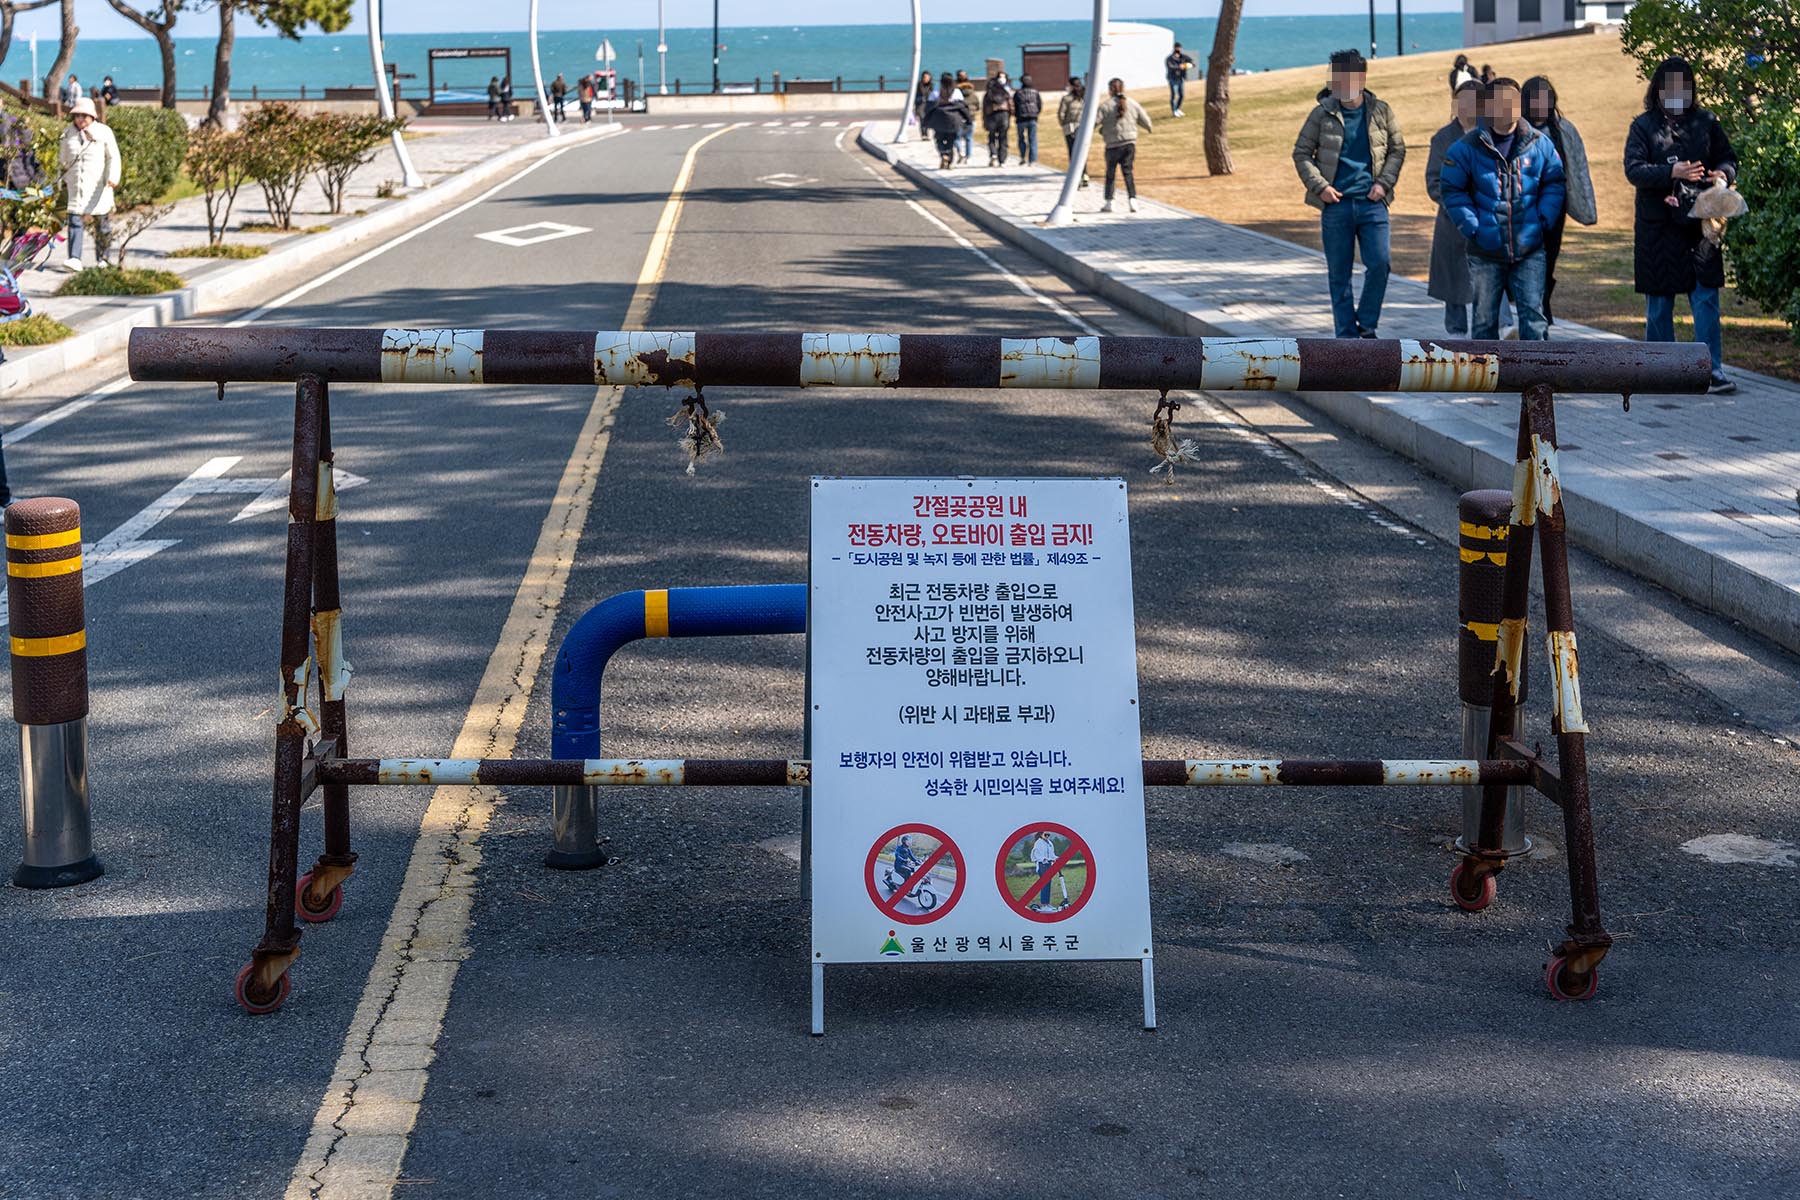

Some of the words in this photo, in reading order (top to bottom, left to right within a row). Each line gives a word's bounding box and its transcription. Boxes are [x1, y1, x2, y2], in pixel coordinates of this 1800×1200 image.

[913, 496, 1004, 518] 간절곶공원
[1010, 495, 1028, 518] 내
[848, 523, 926, 548] 전동차량,
[932, 523, 1004, 546] 오토바이
[1010, 523, 1046, 546] 출입
[1051, 523, 1093, 546] 금지!
[907, 552, 919, 567] 및
[923, 552, 947, 567] 녹지
[952, 552, 977, 567] 등에
[981, 552, 1006, 566] 관한
[1047, 551, 1089, 566] 제49조
[889, 583, 921, 601] 최근
[926, 583, 989, 601] 전동차량
[995, 583, 1058, 601] 출입으로
[875, 604, 954, 622] 안전사고가
[960, 604, 1005, 622] 빈번히
[1011, 604, 1072, 622] 발생하여
[914, 625, 946, 644] 사고
[952, 624, 999, 644] 방지를
[1005, 625, 1035, 644] 위해
[866, 647, 945, 665] 전동차량의
[952, 647, 999, 666] 출입을
[1005, 646, 1083, 665] 금지하오니
[926, 668, 1026, 687] 양해바랍니다.
[899, 705, 936, 724] (위반
[942, 705, 957, 724] 시
[963, 705, 1012, 724] 과태료
[1017, 705, 1055, 724] 부과)
[840, 752, 896, 769] 보행자의
[902, 752, 944, 769] 안전이
[949, 751, 1006, 768] 위협받고
[1011, 750, 1072, 768] 있습니다.
[925, 779, 968, 797] 성숙한
[973, 778, 1043, 796] 시민의식을
[1049, 777, 1125, 795] 보여주세요!
